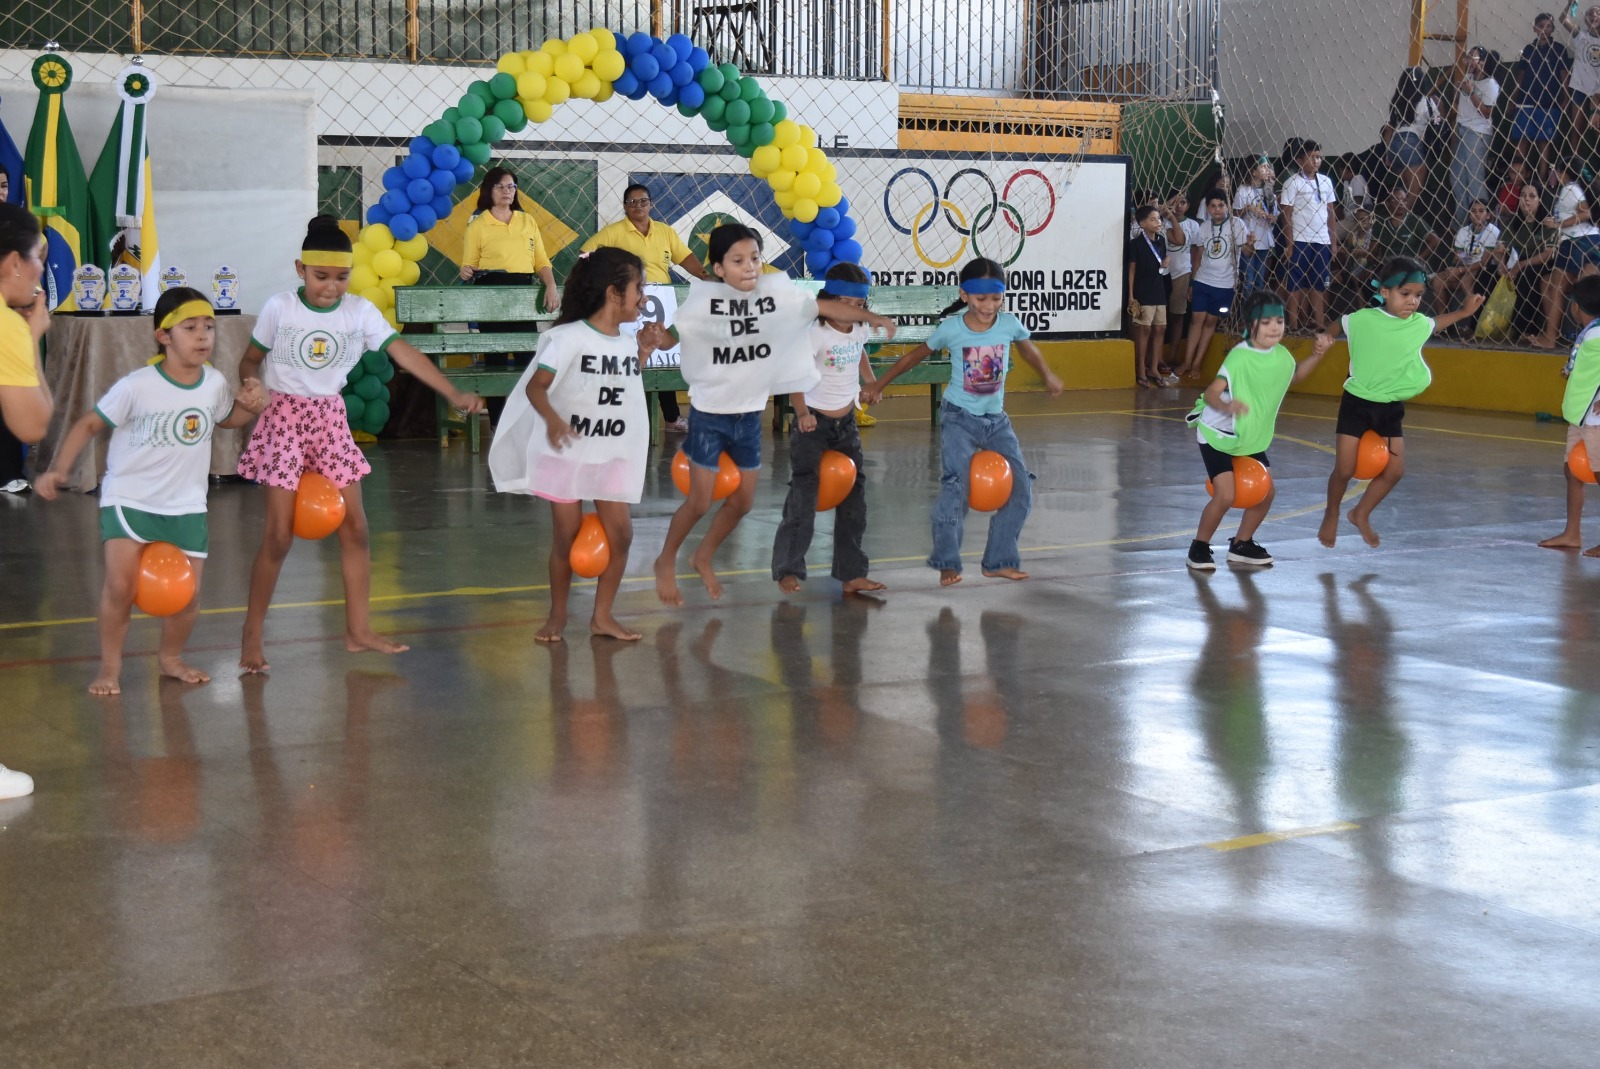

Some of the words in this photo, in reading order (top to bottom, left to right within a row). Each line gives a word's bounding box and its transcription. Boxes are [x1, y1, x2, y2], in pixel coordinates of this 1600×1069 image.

[1051, 270, 1108, 290] LAZER
[730, 317, 760, 337] DE
[712, 343, 772, 365] MAIO
[598, 386, 625, 406] DE
[570, 414, 626, 438] MAIO
